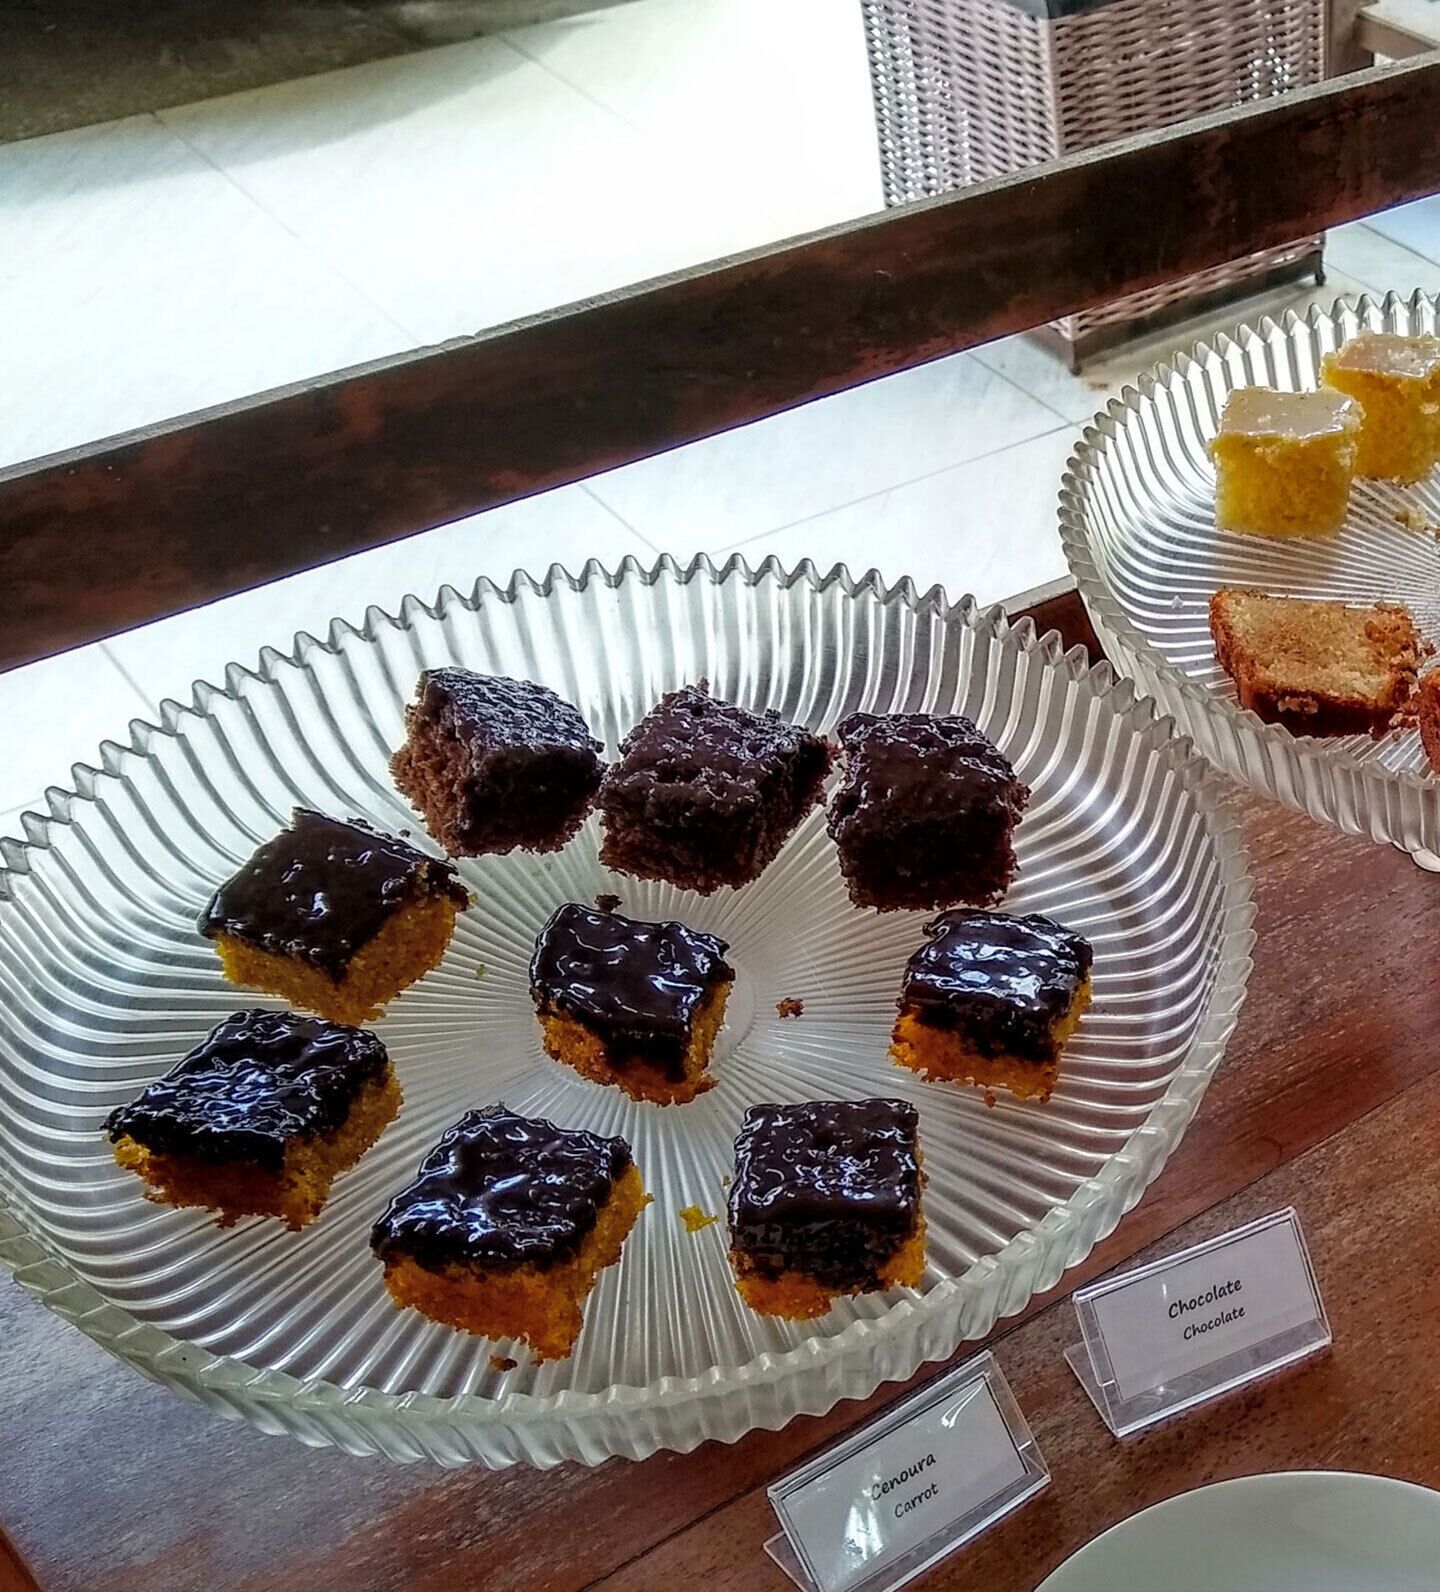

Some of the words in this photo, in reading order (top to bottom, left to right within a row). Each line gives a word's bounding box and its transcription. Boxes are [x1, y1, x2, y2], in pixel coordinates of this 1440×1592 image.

[1168, 1278, 1243, 1319] Chocolate
[1183, 1305, 1246, 1340] Chocolate
[870, 1453, 936, 1502] Cenoura
[894, 1483, 940, 1518] Carrot
